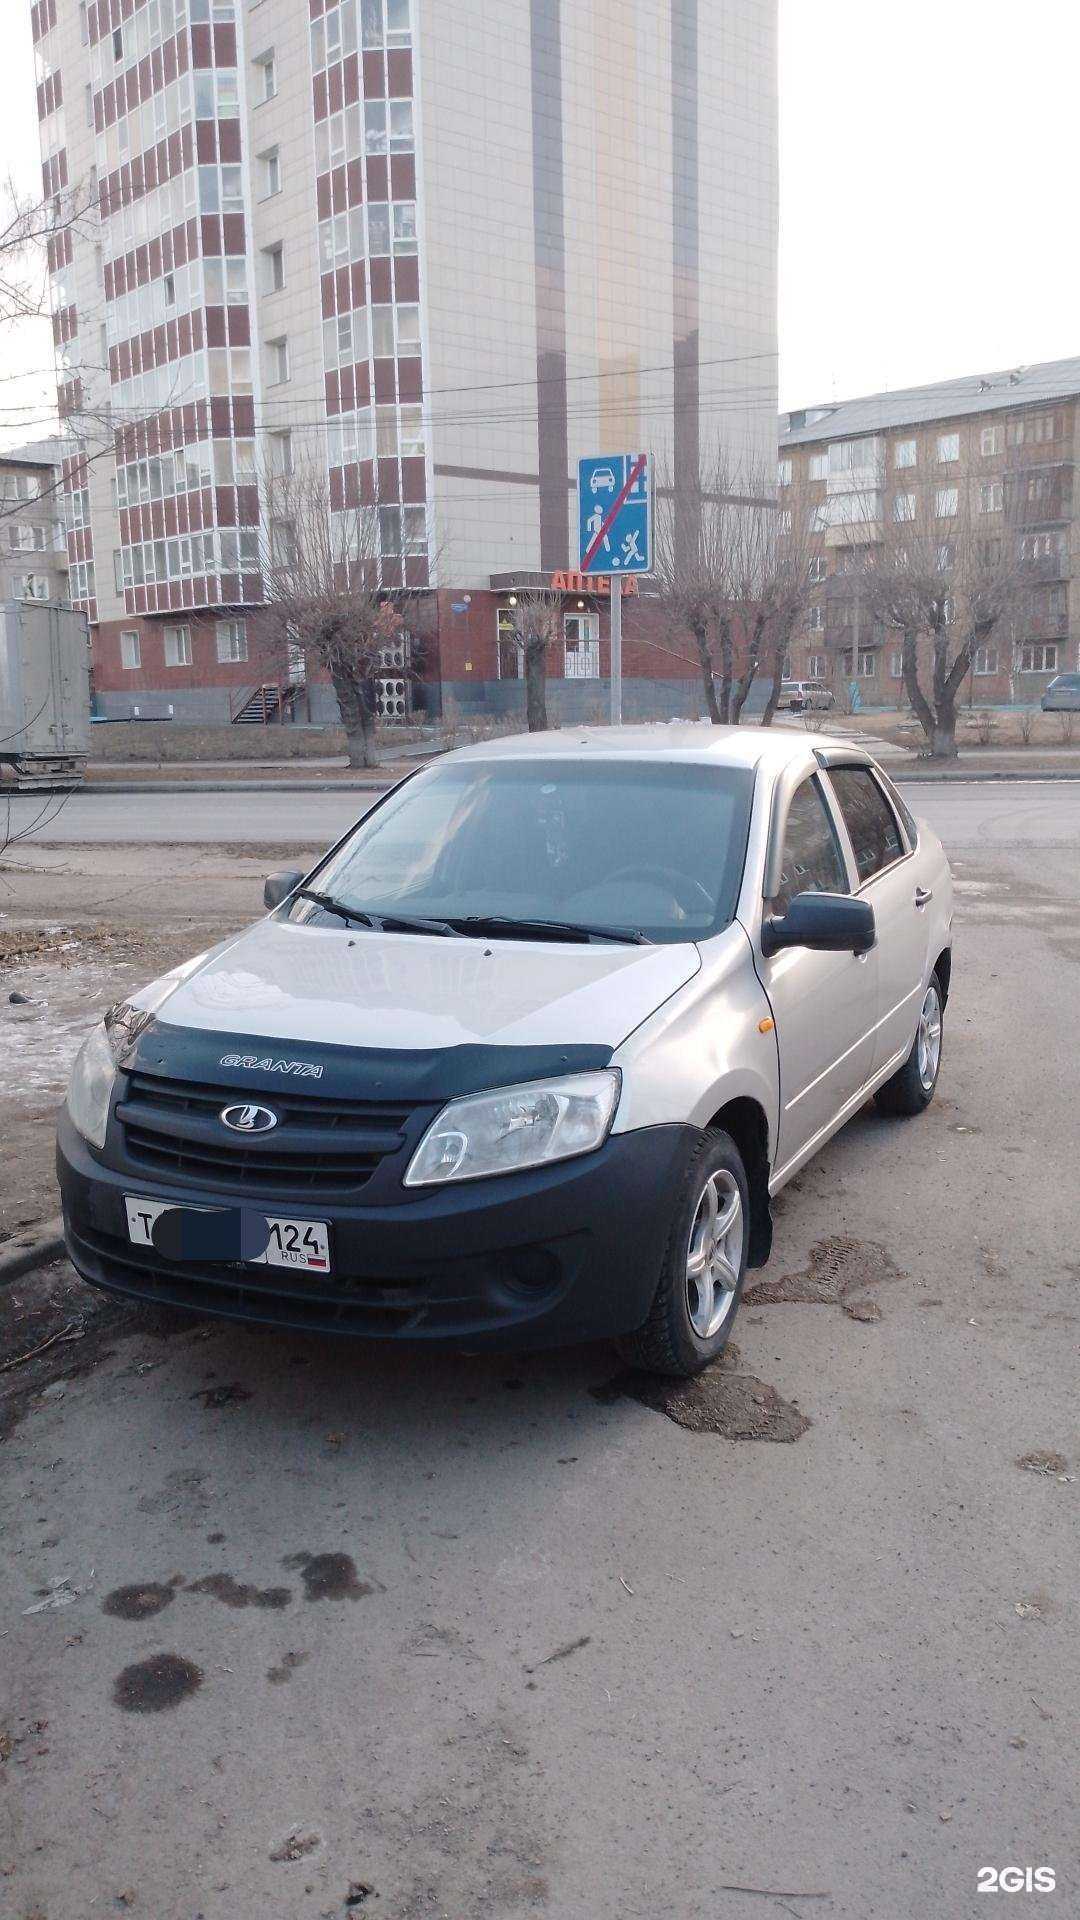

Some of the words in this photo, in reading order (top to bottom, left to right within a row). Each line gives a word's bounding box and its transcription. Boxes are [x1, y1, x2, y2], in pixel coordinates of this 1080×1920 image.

[220, 1054, 324, 1079] GRANTA
[269, 1222, 319, 1255] 124
[281, 1250, 308, 1264] RUS
